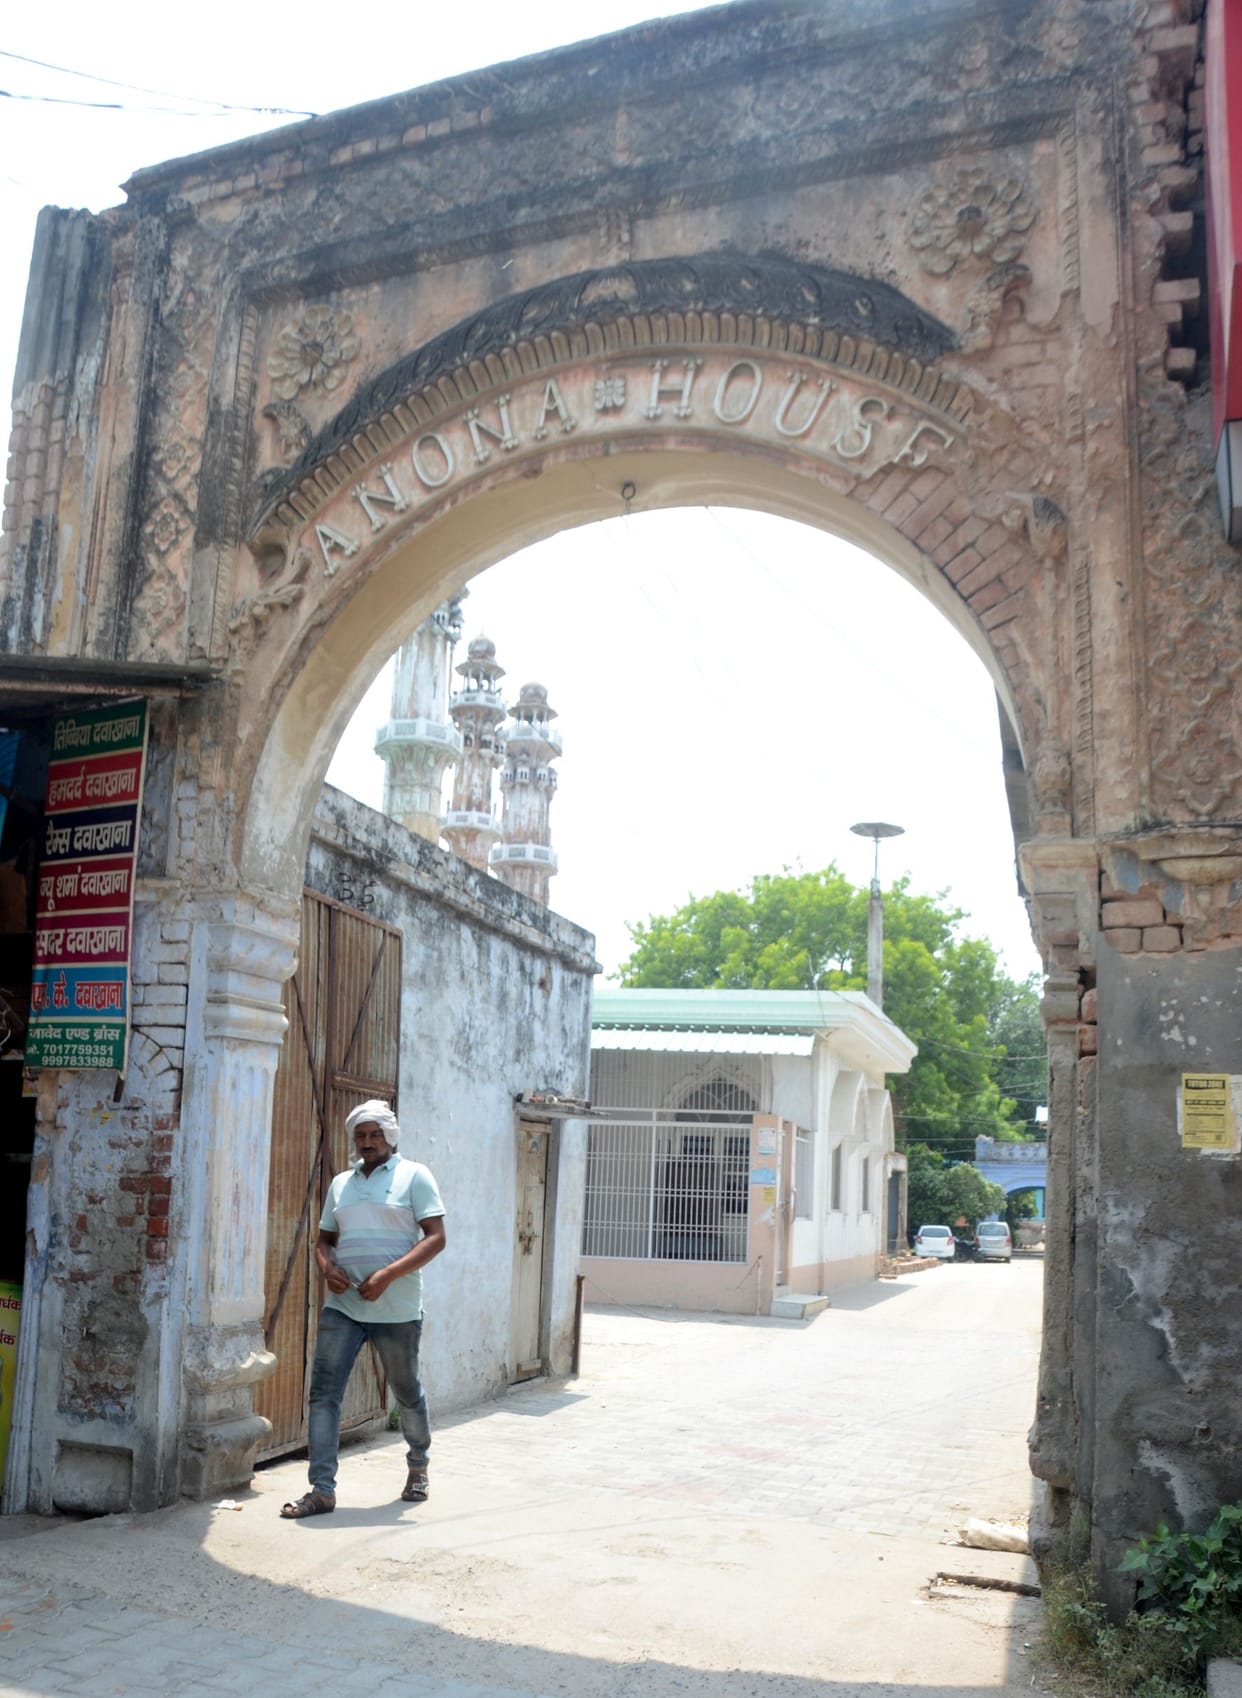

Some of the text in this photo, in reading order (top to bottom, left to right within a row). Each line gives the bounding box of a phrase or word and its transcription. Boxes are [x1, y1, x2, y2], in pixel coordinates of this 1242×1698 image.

[643, 359, 953, 467] HOUSE
[93, 715, 140, 743] दवाखाना
[48, 765, 137, 806] हमदर्द दवाखाना
[73, 821, 132, 852] दवाखाना
[81, 869, 129, 897] दवाखाना
[66, 926, 126, 955] दवाखाना
[75, 981, 124, 1010] दवाखाना
[42, 1056, 114, 1068] 9997833988
[43, 1044, 114, 1056] 7017759351
